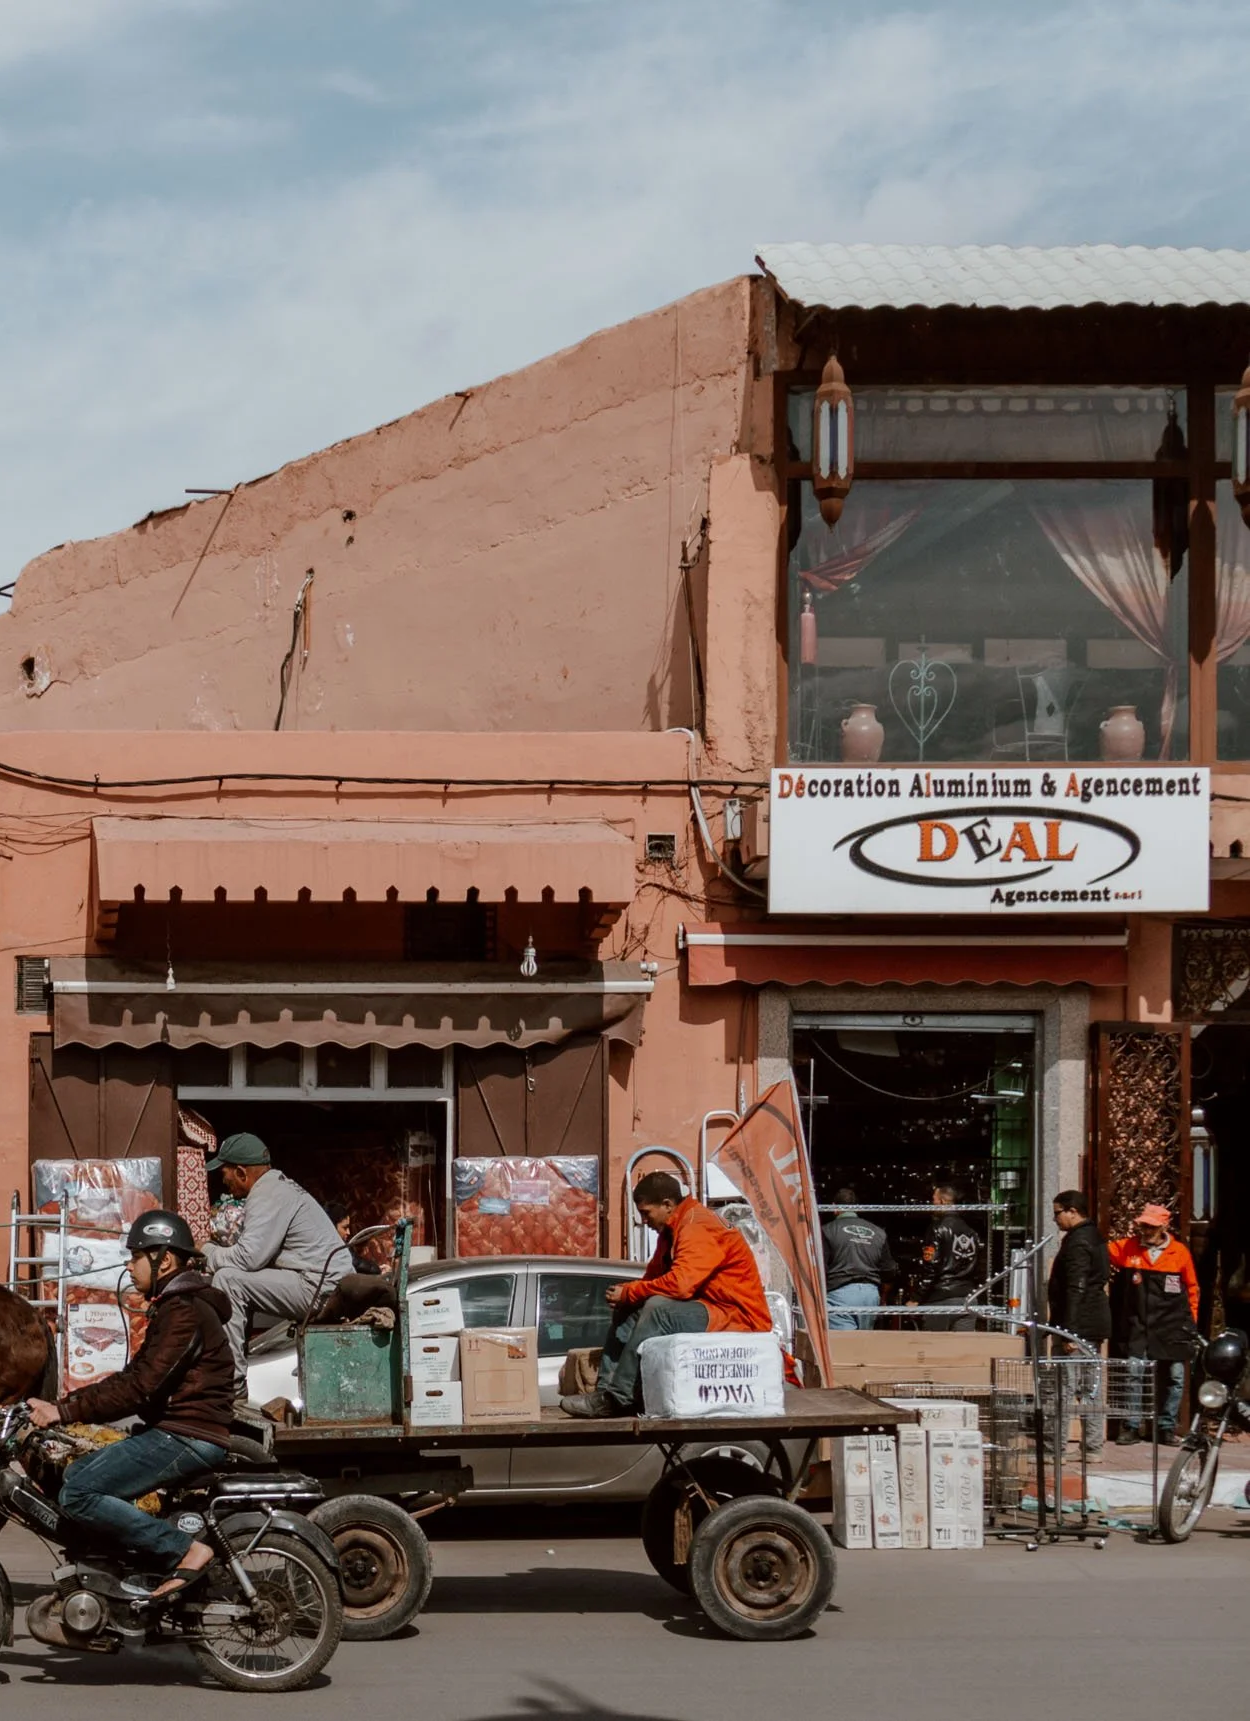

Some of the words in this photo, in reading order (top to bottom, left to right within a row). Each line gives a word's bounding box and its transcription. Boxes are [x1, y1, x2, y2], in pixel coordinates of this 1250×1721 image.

[778, 772, 901, 798] Décoration
[909, 772, 1032, 798] Aluminium
[1040, 774, 1058, 797] &
[1064, 772, 1201, 803] Agencement
[917, 817, 1079, 865] DEAL
[991, 887, 1111, 907] Agencement
